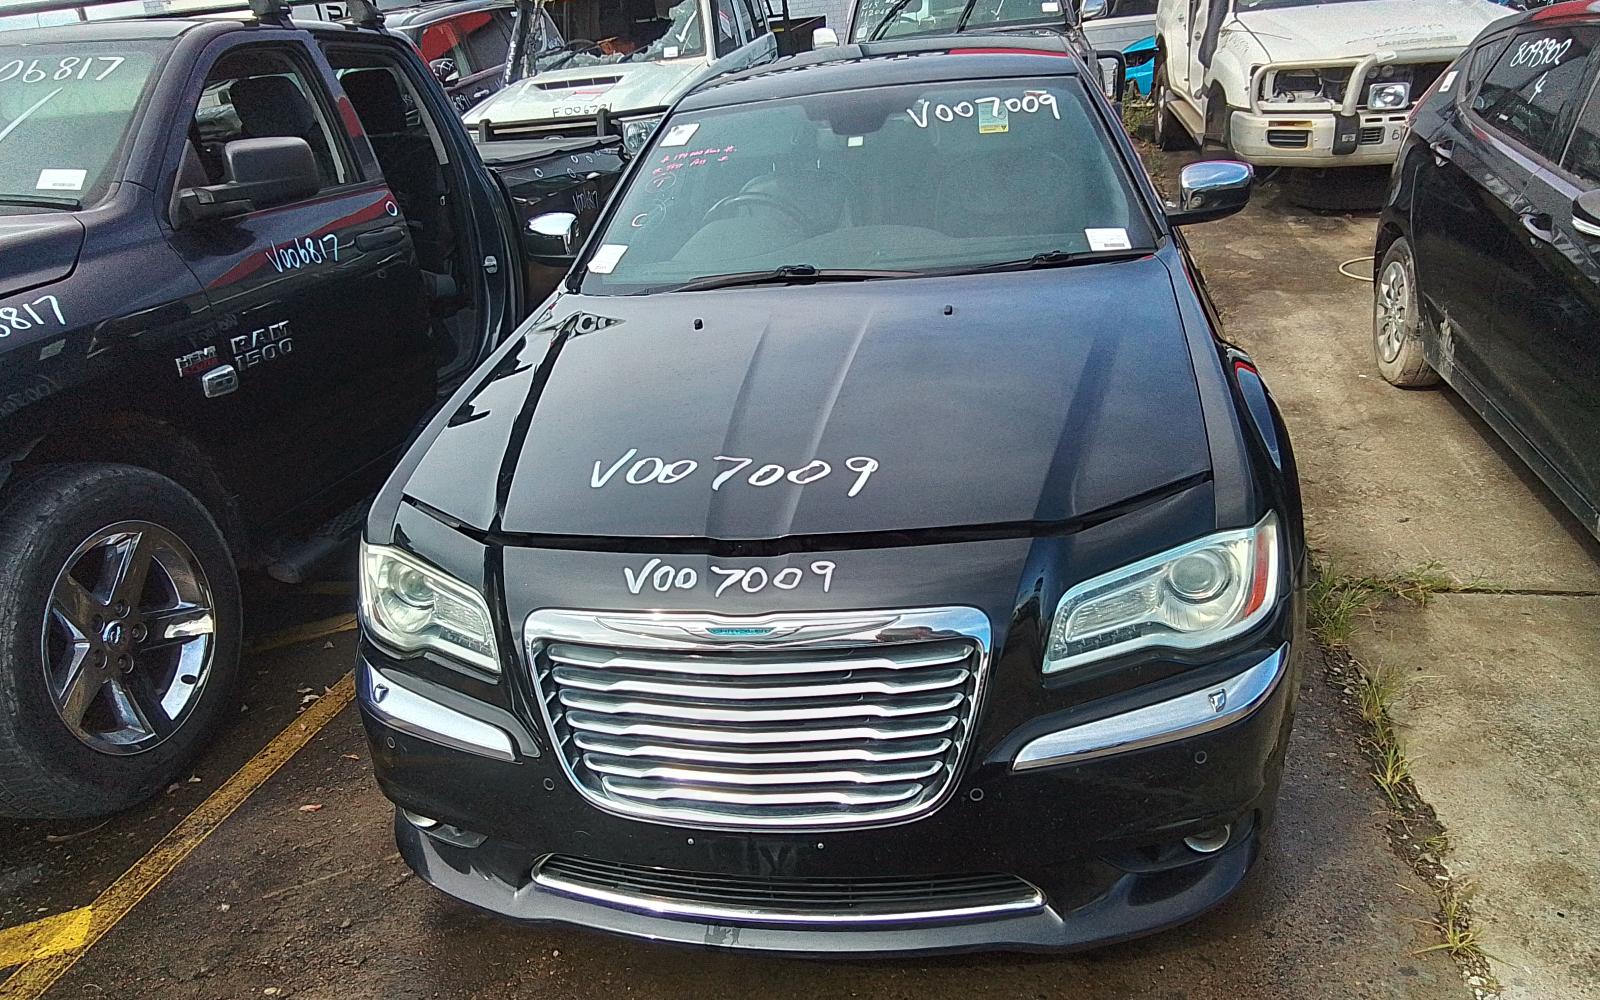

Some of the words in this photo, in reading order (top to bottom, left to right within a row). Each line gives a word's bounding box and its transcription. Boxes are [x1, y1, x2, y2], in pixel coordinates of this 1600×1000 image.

[1509, 37, 1573, 68] 8093902
[906, 93, 1061, 128] V007009
[265, 233, 338, 273] V006817
[230, 320, 290, 355] RAM
[235, 338, 293, 371] 1500
[590, 448, 879, 498] V007009
[624, 558, 837, 598] V007009
